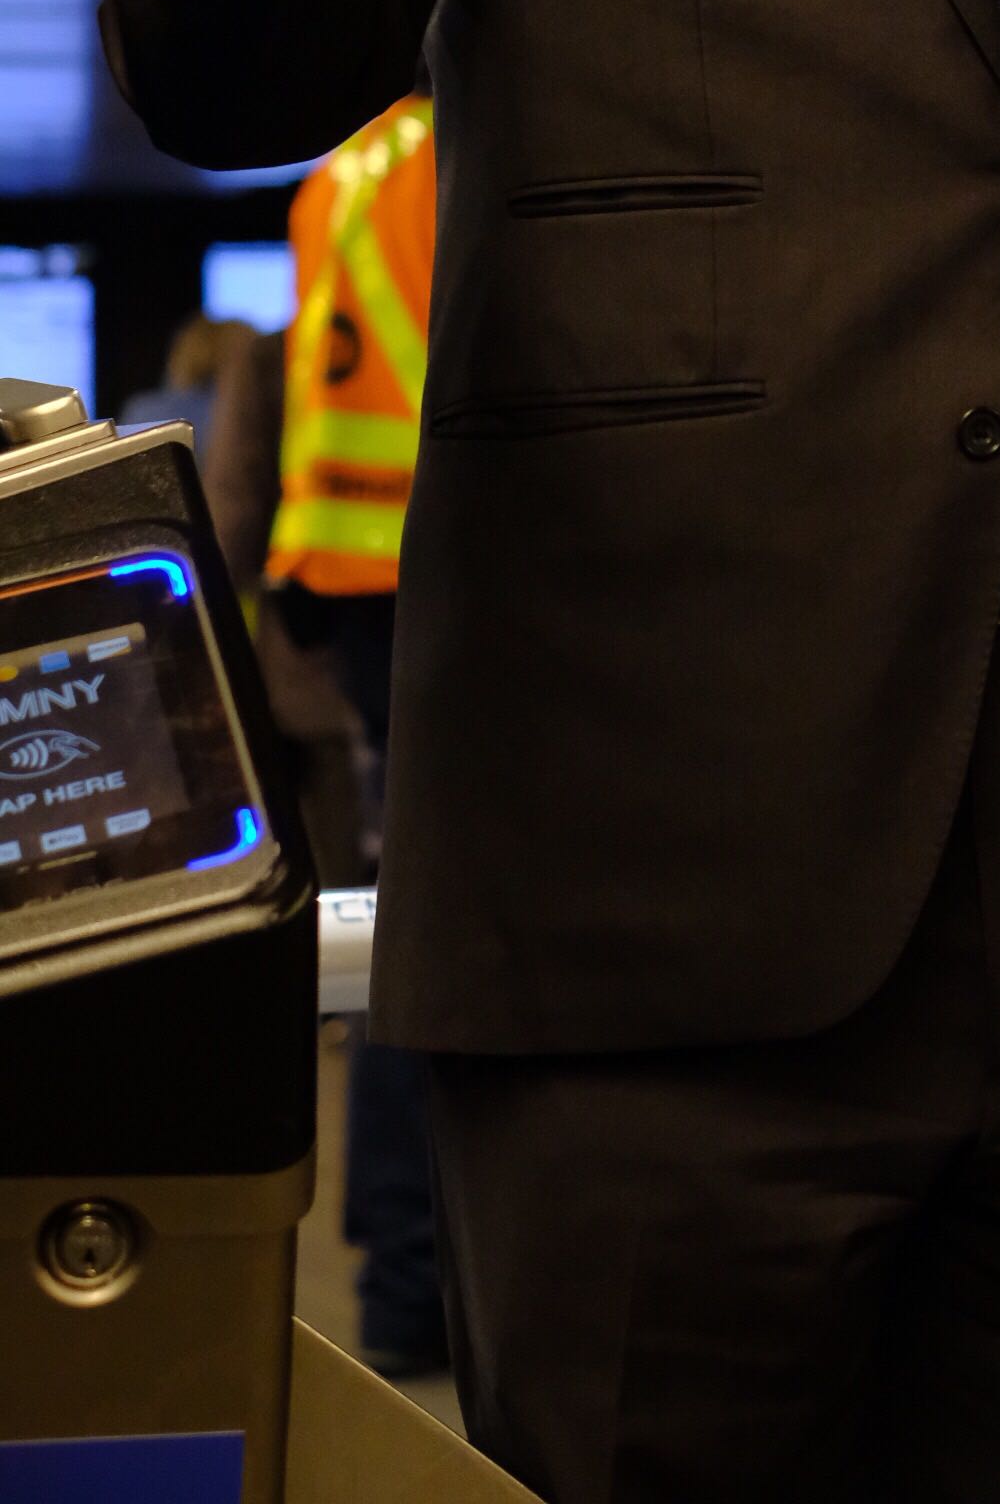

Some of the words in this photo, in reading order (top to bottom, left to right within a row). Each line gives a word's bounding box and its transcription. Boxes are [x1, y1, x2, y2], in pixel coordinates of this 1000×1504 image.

[0, 673, 105, 726] MNY
[0, 793, 37, 818] AP
[42, 770, 127, 807] HERE
